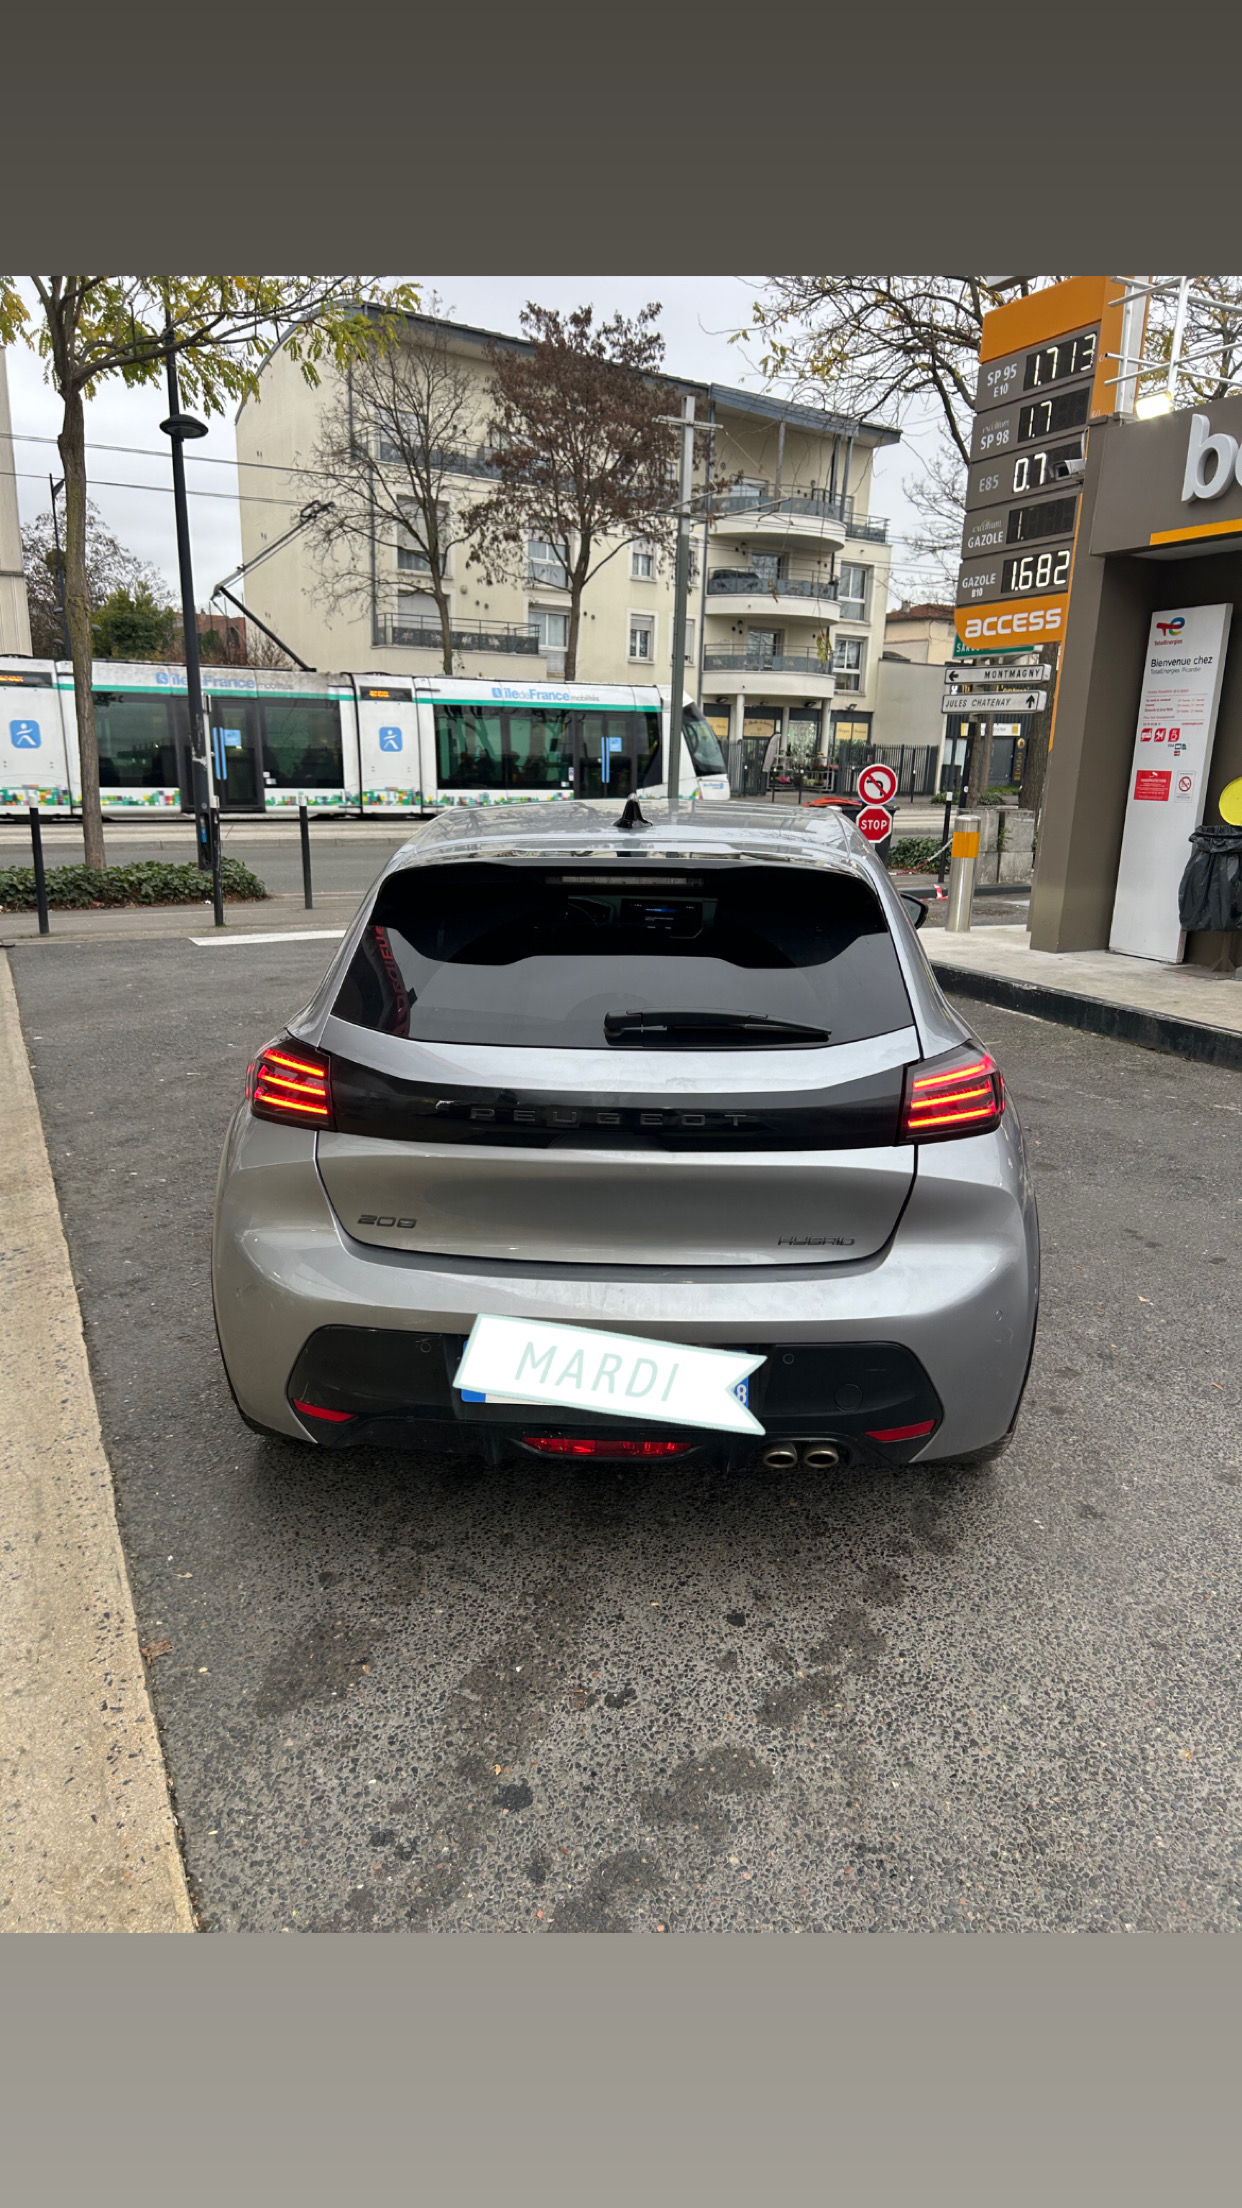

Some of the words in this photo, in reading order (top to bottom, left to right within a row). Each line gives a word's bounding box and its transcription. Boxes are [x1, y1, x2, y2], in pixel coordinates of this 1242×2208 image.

[1033, 333, 1097, 386] 1.713
[987, 369, 1002, 387] SP
[1003, 363, 1018, 381] 95
[993, 383, 1009, 398] E10
[980, 433, 995, 451] SP
[996, 429, 1010, 446] 98
[979, 474, 999, 493] E85
[967, 531, 1004, 548] GAZOLE
[1011, 550, 1070, 591] 1.682
[962, 573, 997, 588] GAZOLE
[1150, 657, 1192, 668] Bienvenue
[1193, 656, 1213, 665] chez
[984, 669, 1040, 679] MONTMAGNY
[945, 699, 967, 708] JULES
[971, 698, 1012, 707] CHATENAY
[860, 819, 888, 831] STOP
[470, 1107, 747, 1127] PEUGEOT
[777, 1236, 855, 1246] HYBRID
